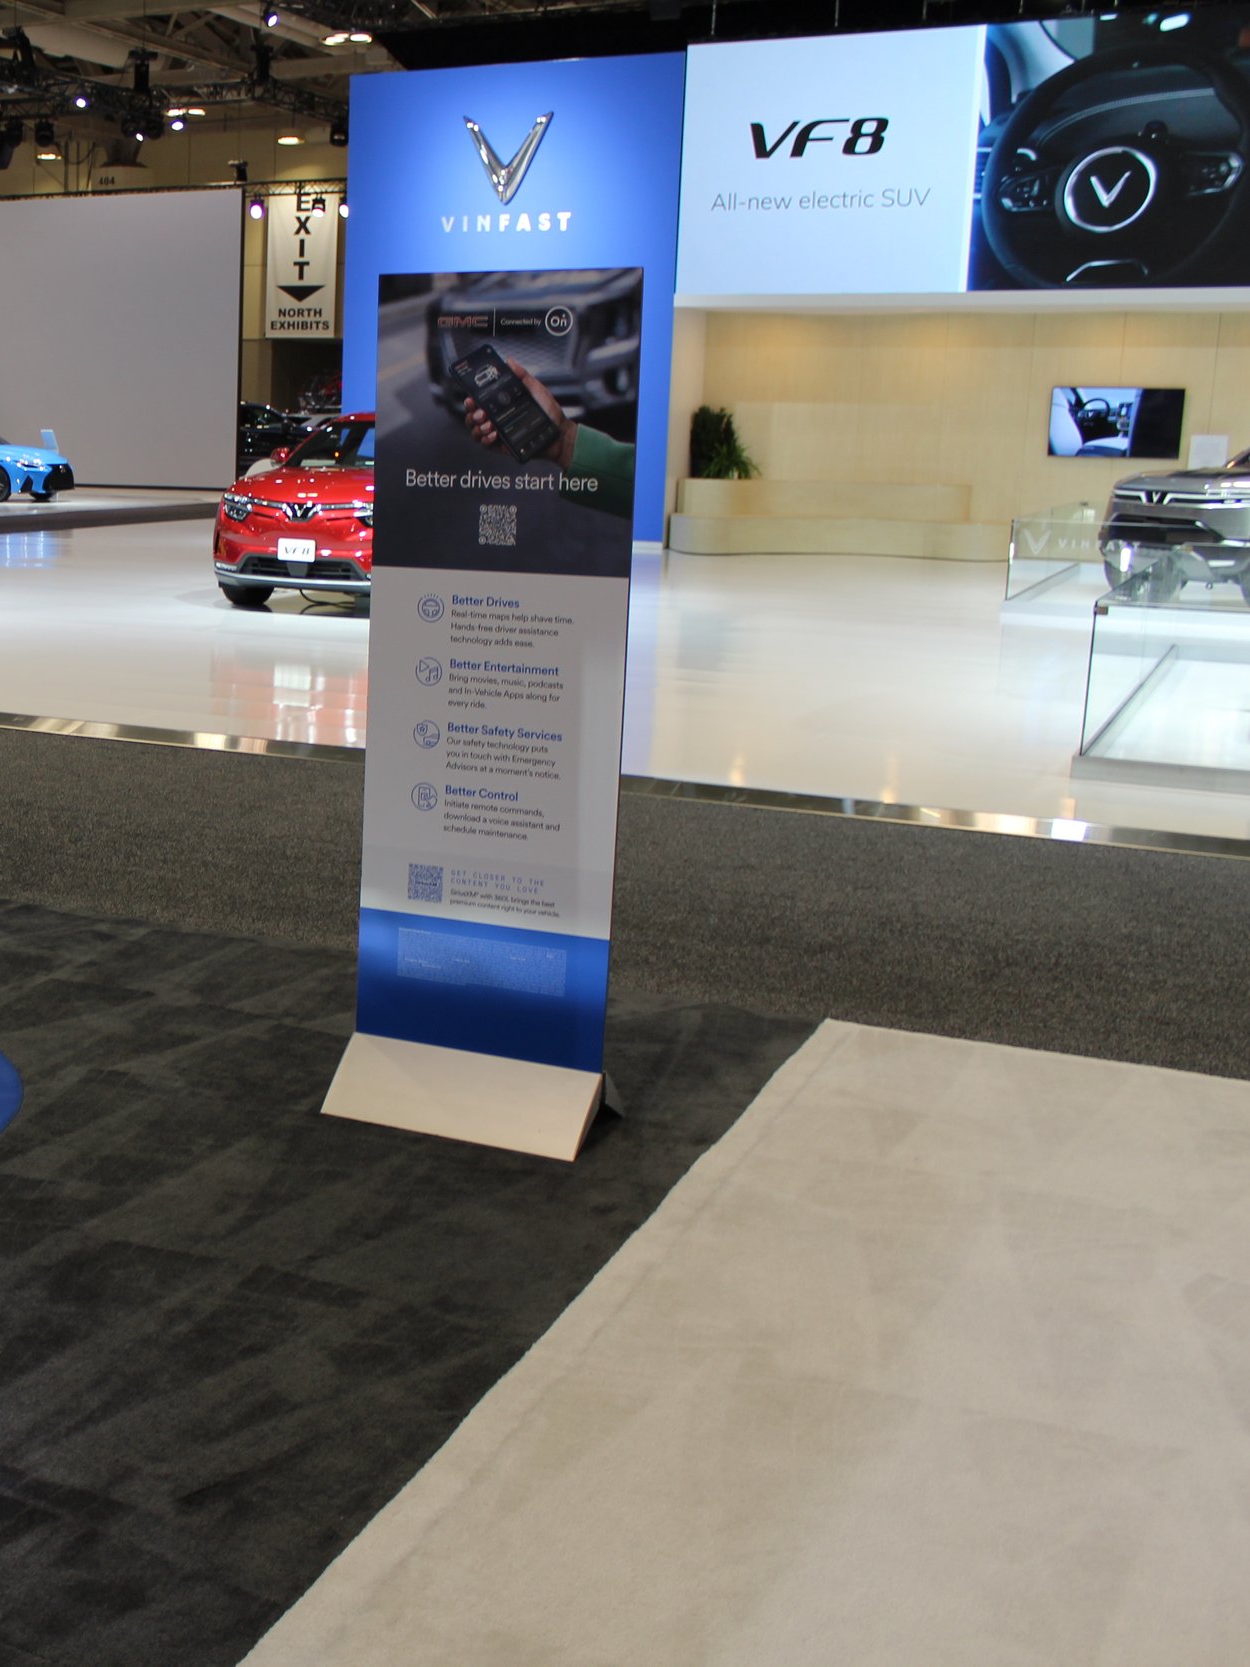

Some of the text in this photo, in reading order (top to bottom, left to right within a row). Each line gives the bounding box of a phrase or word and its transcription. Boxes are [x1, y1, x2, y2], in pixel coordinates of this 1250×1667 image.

[750, 117, 889, 159] VF8
[711, 188, 931, 211] All-new electric SUV
[442, 212, 571, 232] VINFAST
[294, 192, 311, 280] EXIT
[278, 308, 322, 318] NORTH
[270, 320, 329, 331] EXHIBITS
[437, 316, 488, 328] GMC
[533, 318, 542, 326] by
[406, 469, 598, 492] Better drives start here
[452, 595, 519, 608] Better Drives
[451, 610, 487, 619] Real-time
[489, 613, 510, 621] maps
[512, 612, 528, 622] help
[530, 614, 552, 623] shave
[451, 623, 558, 636] Hands-free driver assistance
[450, 635, 493, 646] technology
[494, 638, 513, 646] adds
[450, 659, 559, 676] Better Entertainment
[449, 674, 468, 684] Bring
[528, 681, 563, 689] podcasts
[449, 687, 462, 695] and
[503, 690, 524, 700] Apps
[526, 692, 547, 702] along
[448, 701, 468, 709] every
[447, 722, 562, 742] Better Safety Services
[447, 738, 548, 754] Our safety technology puts
[446, 762, 478, 772] Advisors
[470, 752, 491, 761] touch
[494, 754, 510, 762] with
[512, 756, 556, 768] Emergency
[445, 785, 518, 801] Better Control
[445, 800, 469, 809] Initiate
[471, 803, 498, 812] remote
[443, 812, 481, 823] download
[489, 817, 509, 826] voice
[511, 819, 543, 830] assistant
[545, 823, 560, 832] and
[443, 824, 477, 835] schedule
[451, 878, 538, 894] CONTENT YOU LOVE
[473, 872, 505, 881] CLOSER
[530, 878, 544, 886] THE
